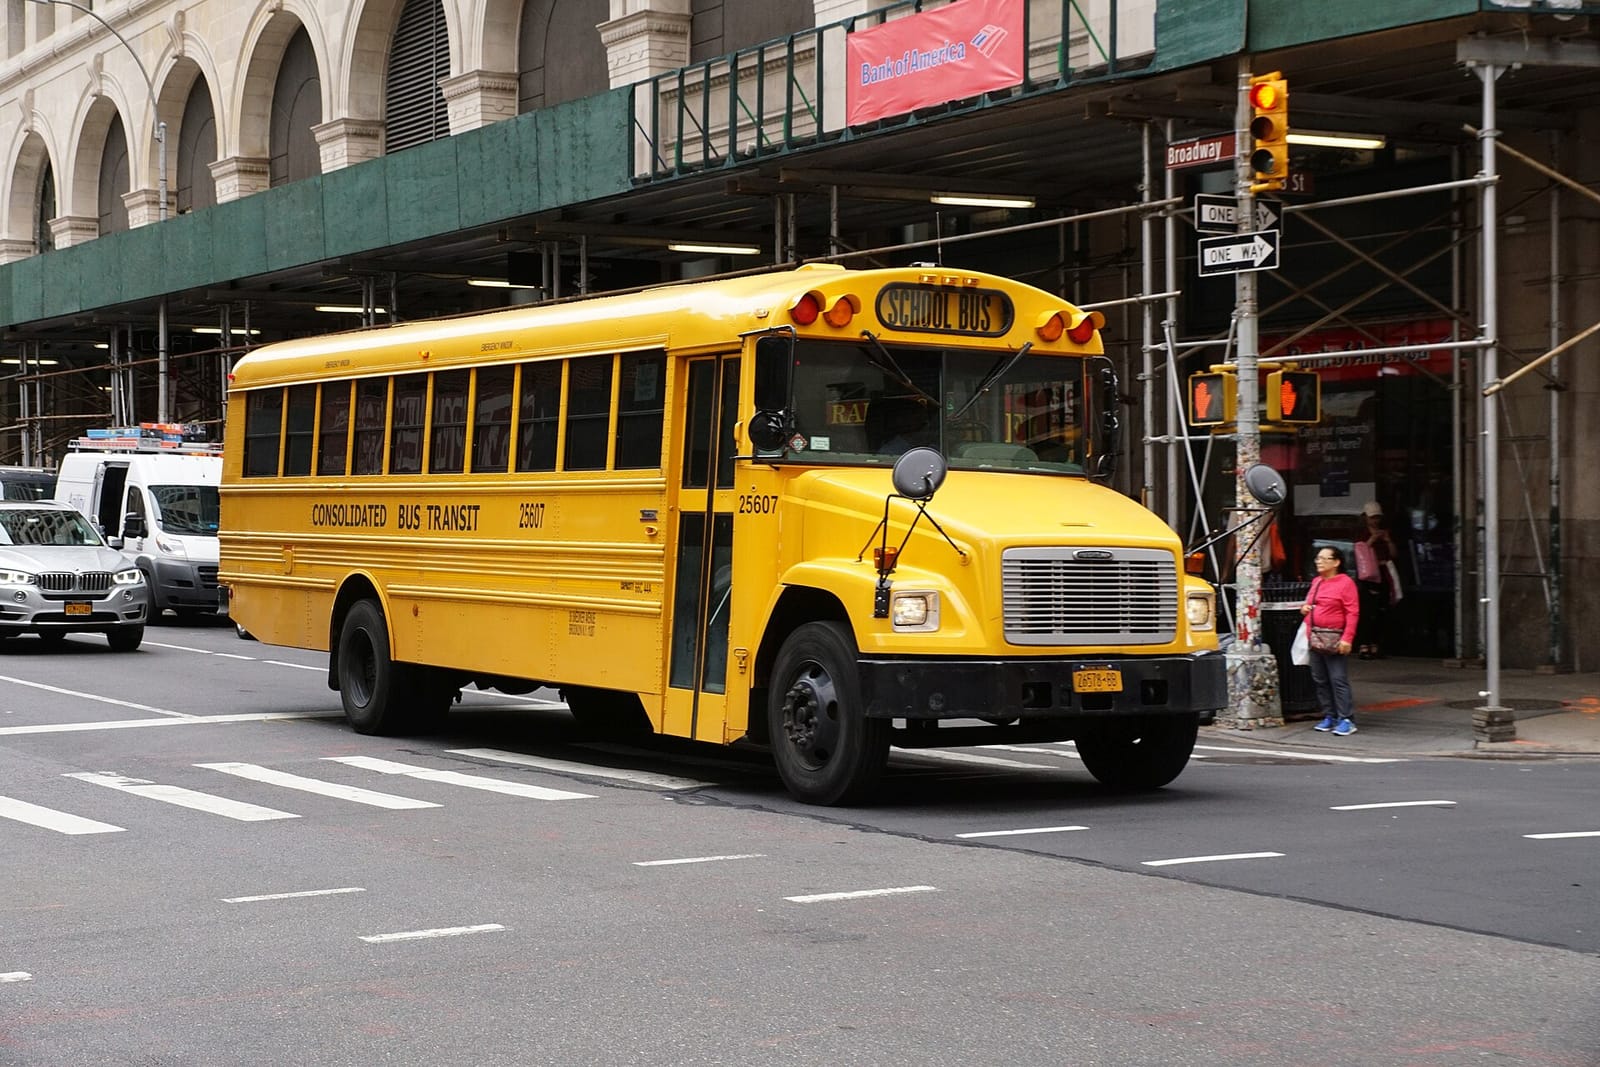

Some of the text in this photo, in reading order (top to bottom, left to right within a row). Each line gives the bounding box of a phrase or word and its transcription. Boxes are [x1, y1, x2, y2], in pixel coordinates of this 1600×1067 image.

[861, 41, 966, 86] Bank of America
[1168, 141, 1222, 165] Broadway
[1292, 174, 1305, 192] St
[1209, 207, 1233, 222] ONE
[1210, 244, 1266, 263] ONE WAY
[888, 289, 992, 331] SCHOOL BUS
[519, 503, 545, 529] 25607
[739, 495, 779, 514] 25607
[312, 504, 481, 531] CONSOLIDATED BUS TRANSIT
